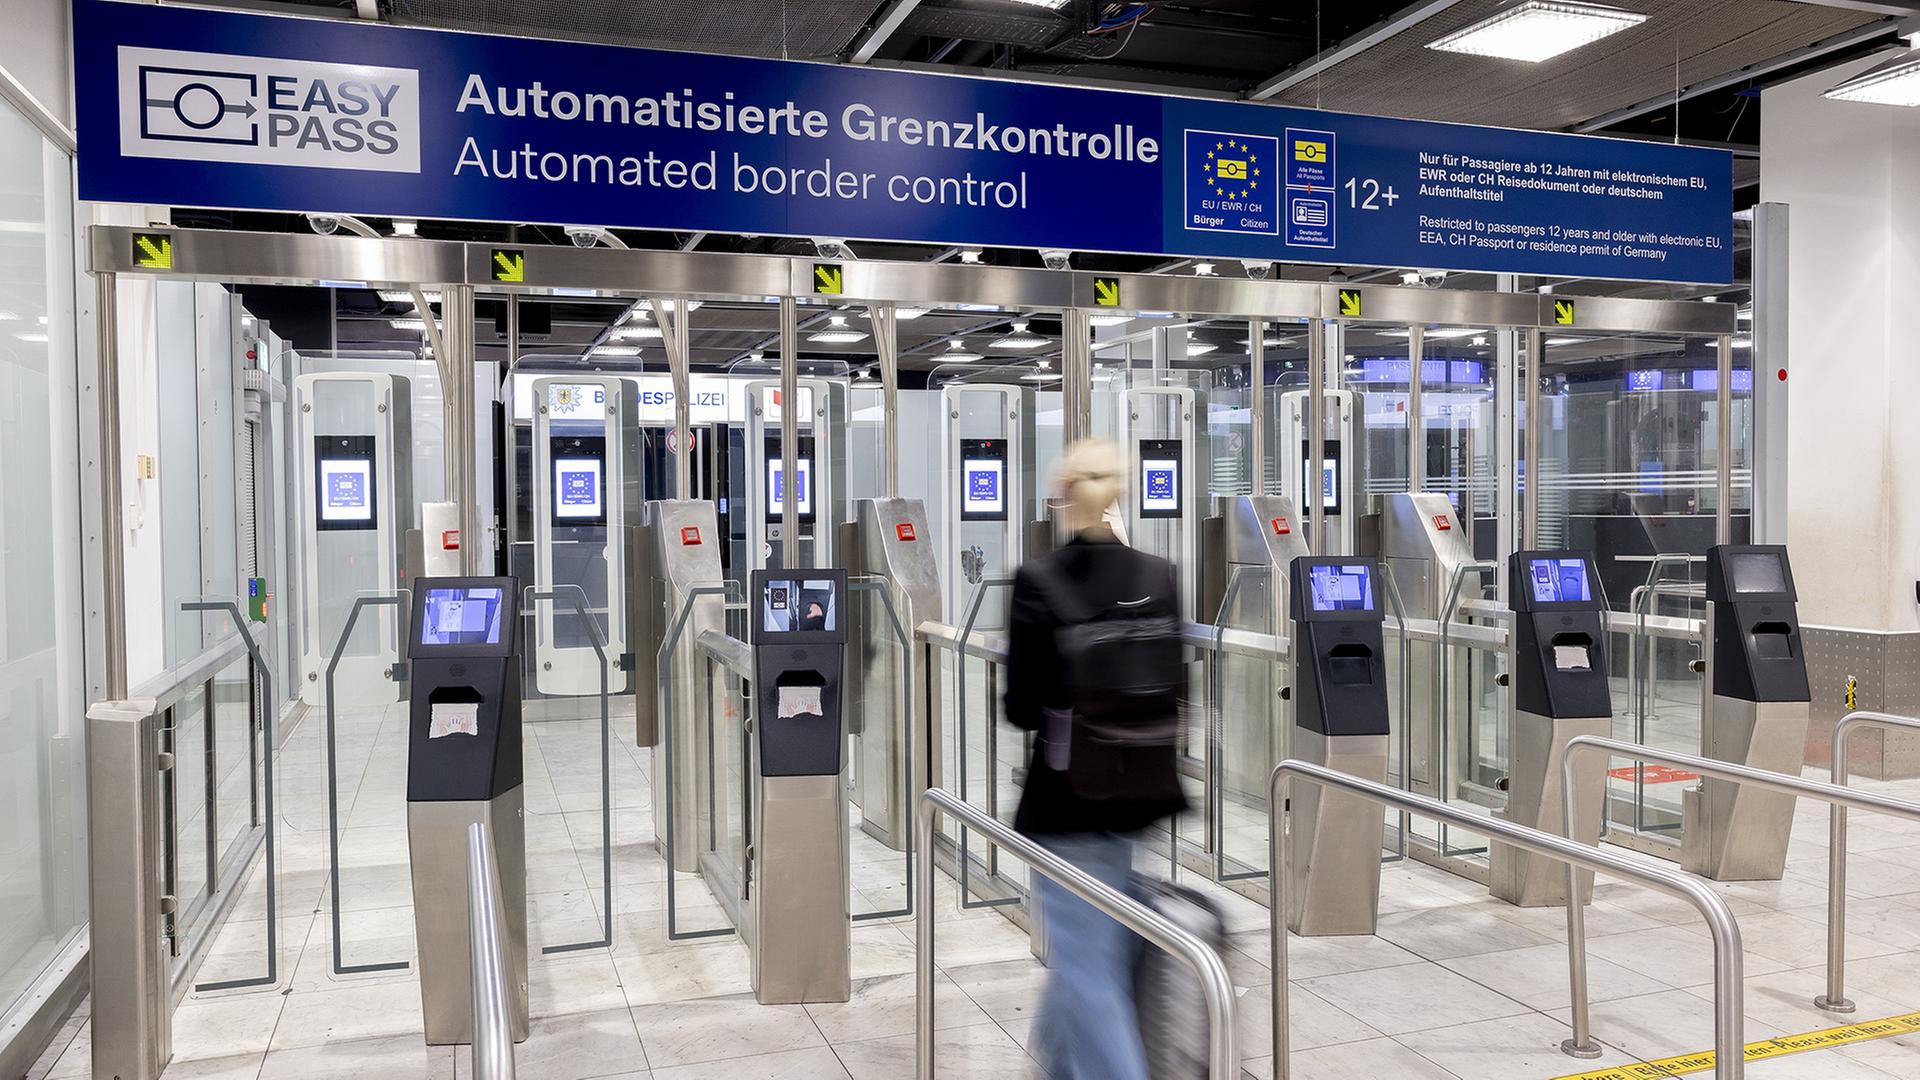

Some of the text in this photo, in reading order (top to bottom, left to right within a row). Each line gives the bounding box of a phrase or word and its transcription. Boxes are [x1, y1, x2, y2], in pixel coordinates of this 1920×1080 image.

[268, 75, 401, 118] EASY
[269, 114, 399, 155] PASS
[456, 74, 1159, 163] Automatisierte Grenzkontrolle
[454, 137, 1027, 209] Automated border control
[1419, 152, 1707, 190] Nur für Passagiere ab 12 Jahren mit elektronischem EU,
[1419, 168, 1663, 200] EWR oder CH Reisedokument oder deutschem
[1202, 199, 1215, 209] EU
[1222, 201, 1243, 212] EWR
[1249, 203, 1262, 212] CH
[1345, 177, 1400, 210] 12+
[1419, 184, 1503, 201] Aufenthaltstitel
[1193, 214, 1268, 229] Bürger Citizen
[1419, 215, 1472, 230] Restricted
[1475, 220, 1485, 231] to
[1487, 223, 1545, 237] passengers
[1549, 226, 1560, 237] 12
[1563, 228, 1590, 240] years
[1592, 230, 1610, 241] and
[1612, 231, 1636, 242] older
[1639, 232, 1657, 244] with
[1660, 234, 1704, 247] electronic
[1419, 231, 1667, 261] EEA, CH Passport or residence permit of Germany
[1675, 1057, 1713, 1068] hier
[1825, 1029, 1863, 1040] wait
[1855, 1024, 1896, 1035] here
